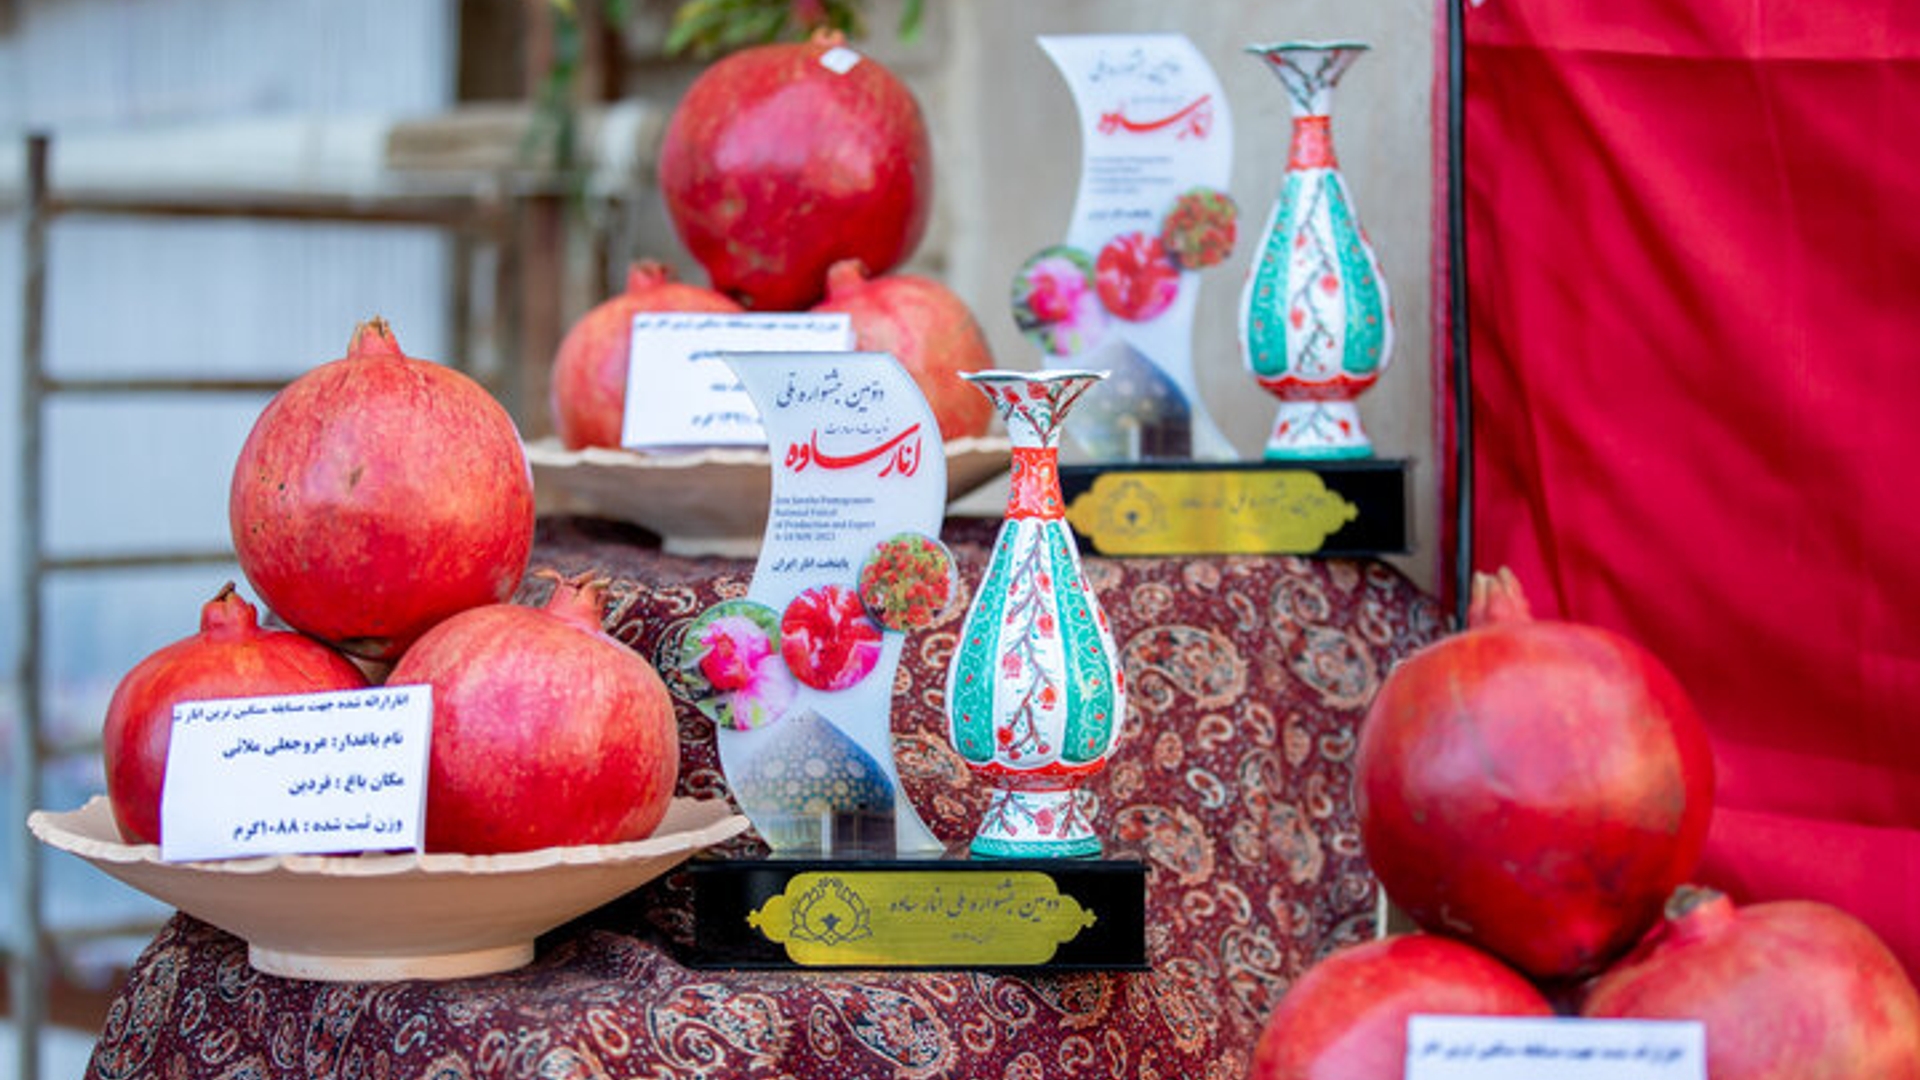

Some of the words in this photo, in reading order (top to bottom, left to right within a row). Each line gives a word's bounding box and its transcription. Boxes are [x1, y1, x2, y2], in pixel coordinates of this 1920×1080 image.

[785, 422, 921, 473] ساوه
[878, 436, 921, 477] انار
[272, 700, 304, 713] مسابقه
[339, 696, 361, 709] شده
[382, 732, 404, 748] نام
[344, 774, 366, 793] باغ
[370, 771, 405, 792] مکان
[312, 817, 341, 833] شده
[345, 812, 371, 831] ثبت
[373, 818, 403, 834] وزن
